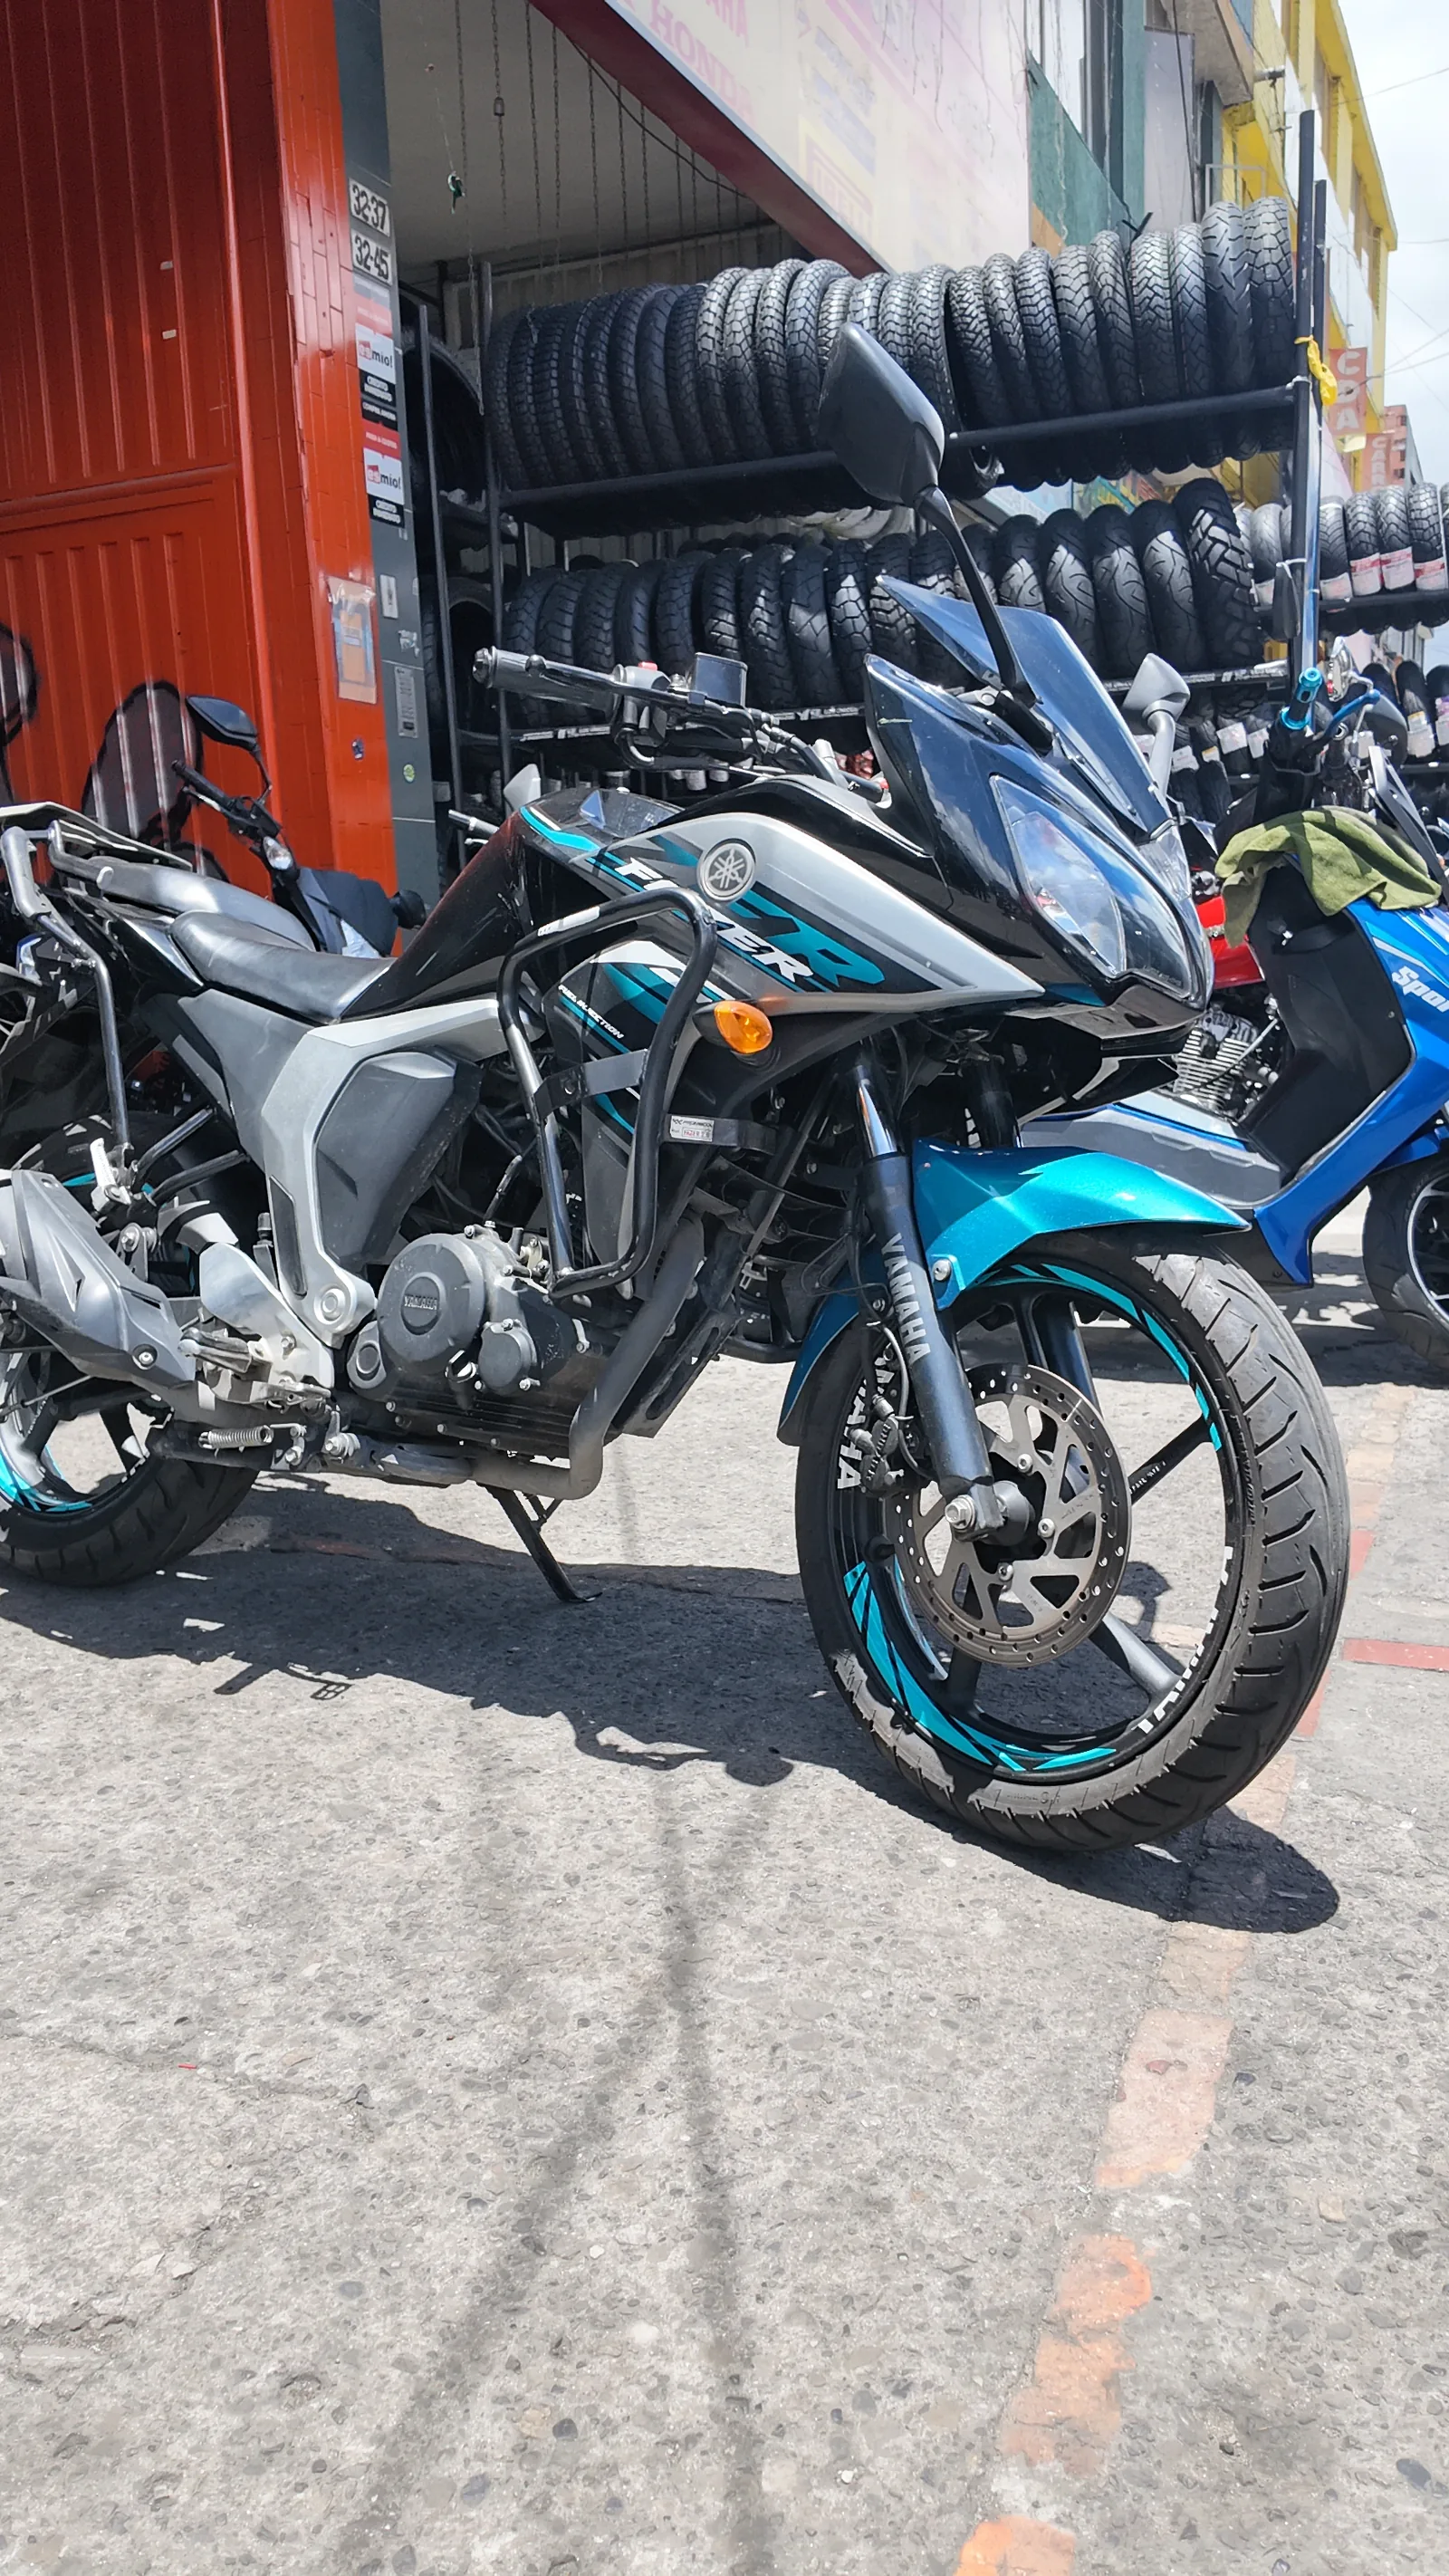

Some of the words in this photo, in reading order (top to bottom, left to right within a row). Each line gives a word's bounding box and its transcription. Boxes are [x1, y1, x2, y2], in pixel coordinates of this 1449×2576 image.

[351, 184, 387, 231] 32-37
[354, 235, 389, 281] 32-45
[614, 857, 814, 984] FZER
[577, 999, 625, 1039] INJECTION
[404, 1295, 438, 1310] YAMAHA
[881, 1233, 932, 1366] YAMAHA
